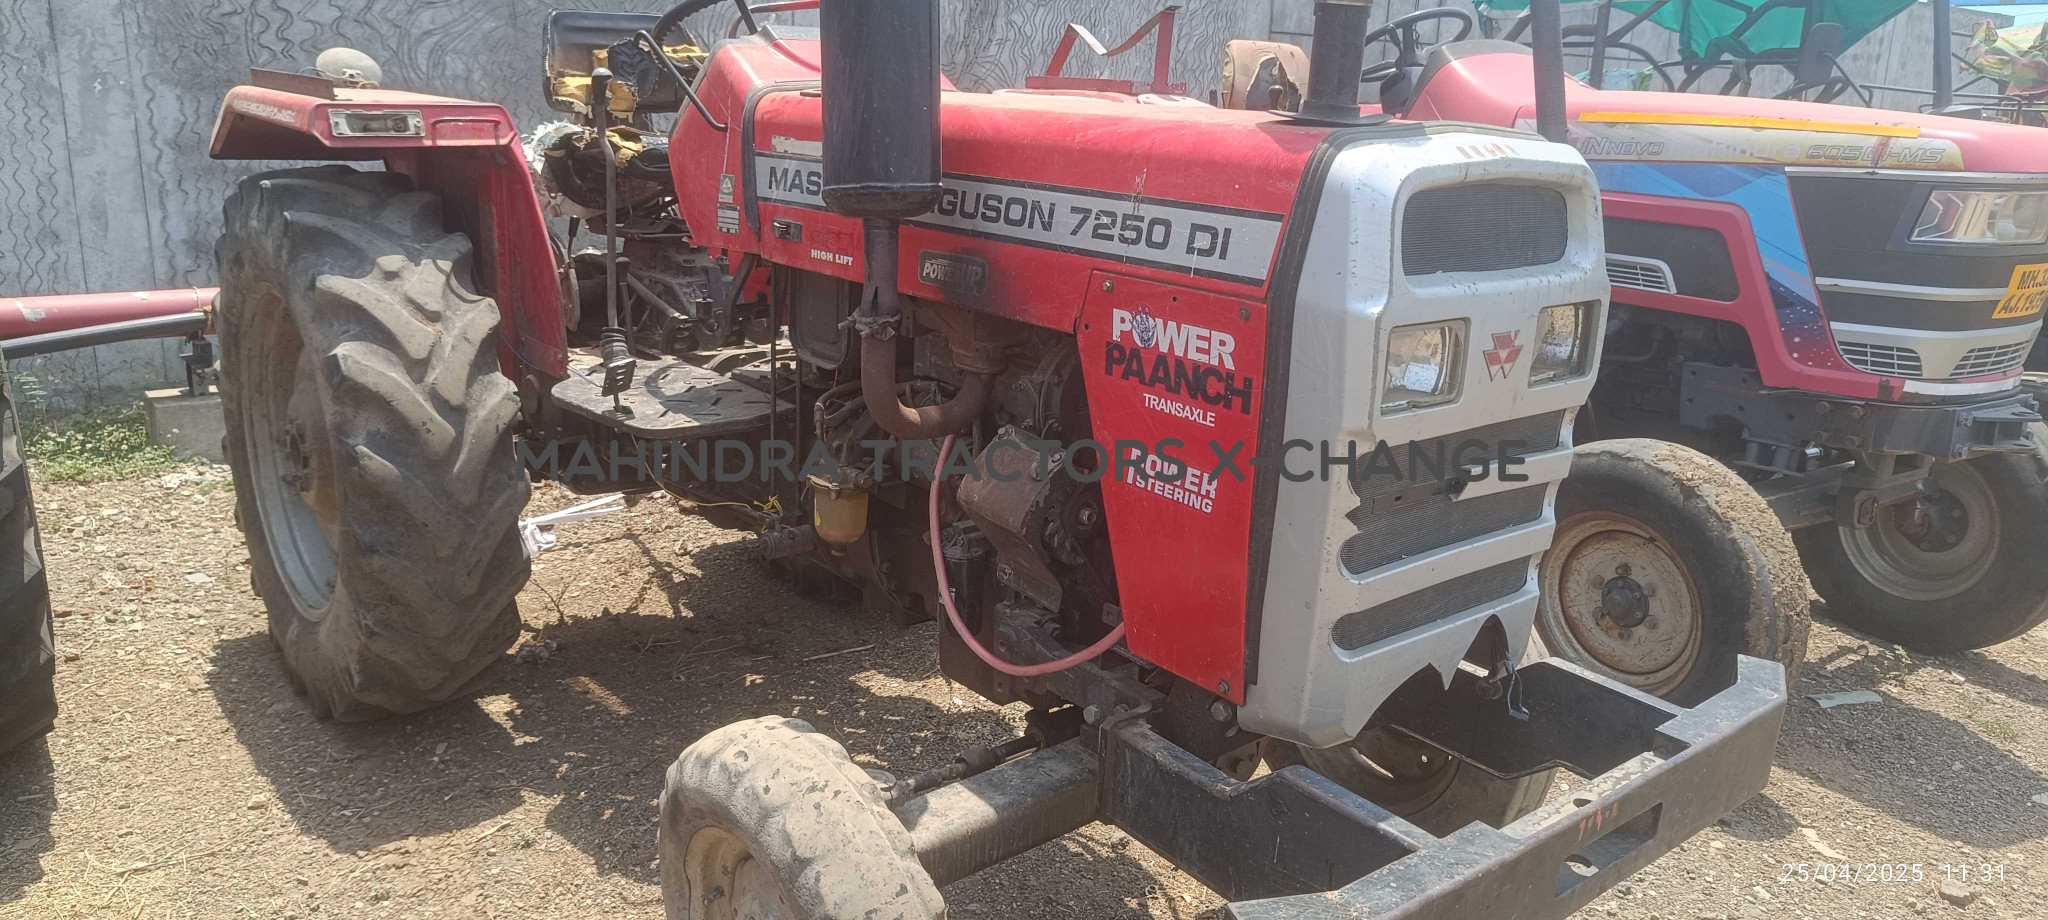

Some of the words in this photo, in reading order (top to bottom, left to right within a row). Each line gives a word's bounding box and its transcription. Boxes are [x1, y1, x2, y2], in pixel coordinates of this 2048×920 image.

[768, 167, 823, 196] MAS
[929, 188, 1055, 233] GUSON
[1069, 206, 1172, 250] 7250
[1185, 223, 1232, 260] DI
[810, 249, 834, 262] HIGH
[835, 253, 854, 266] LIFT
[1112, 304, 1235, 370] POWER
[1104, 341, 1253, 415] PAANCH
[1143, 393, 1216, 427] TRANSAXLE
[1126, 447, 1218, 498] POWER
[1135, 478, 1213, 513] STEERING
